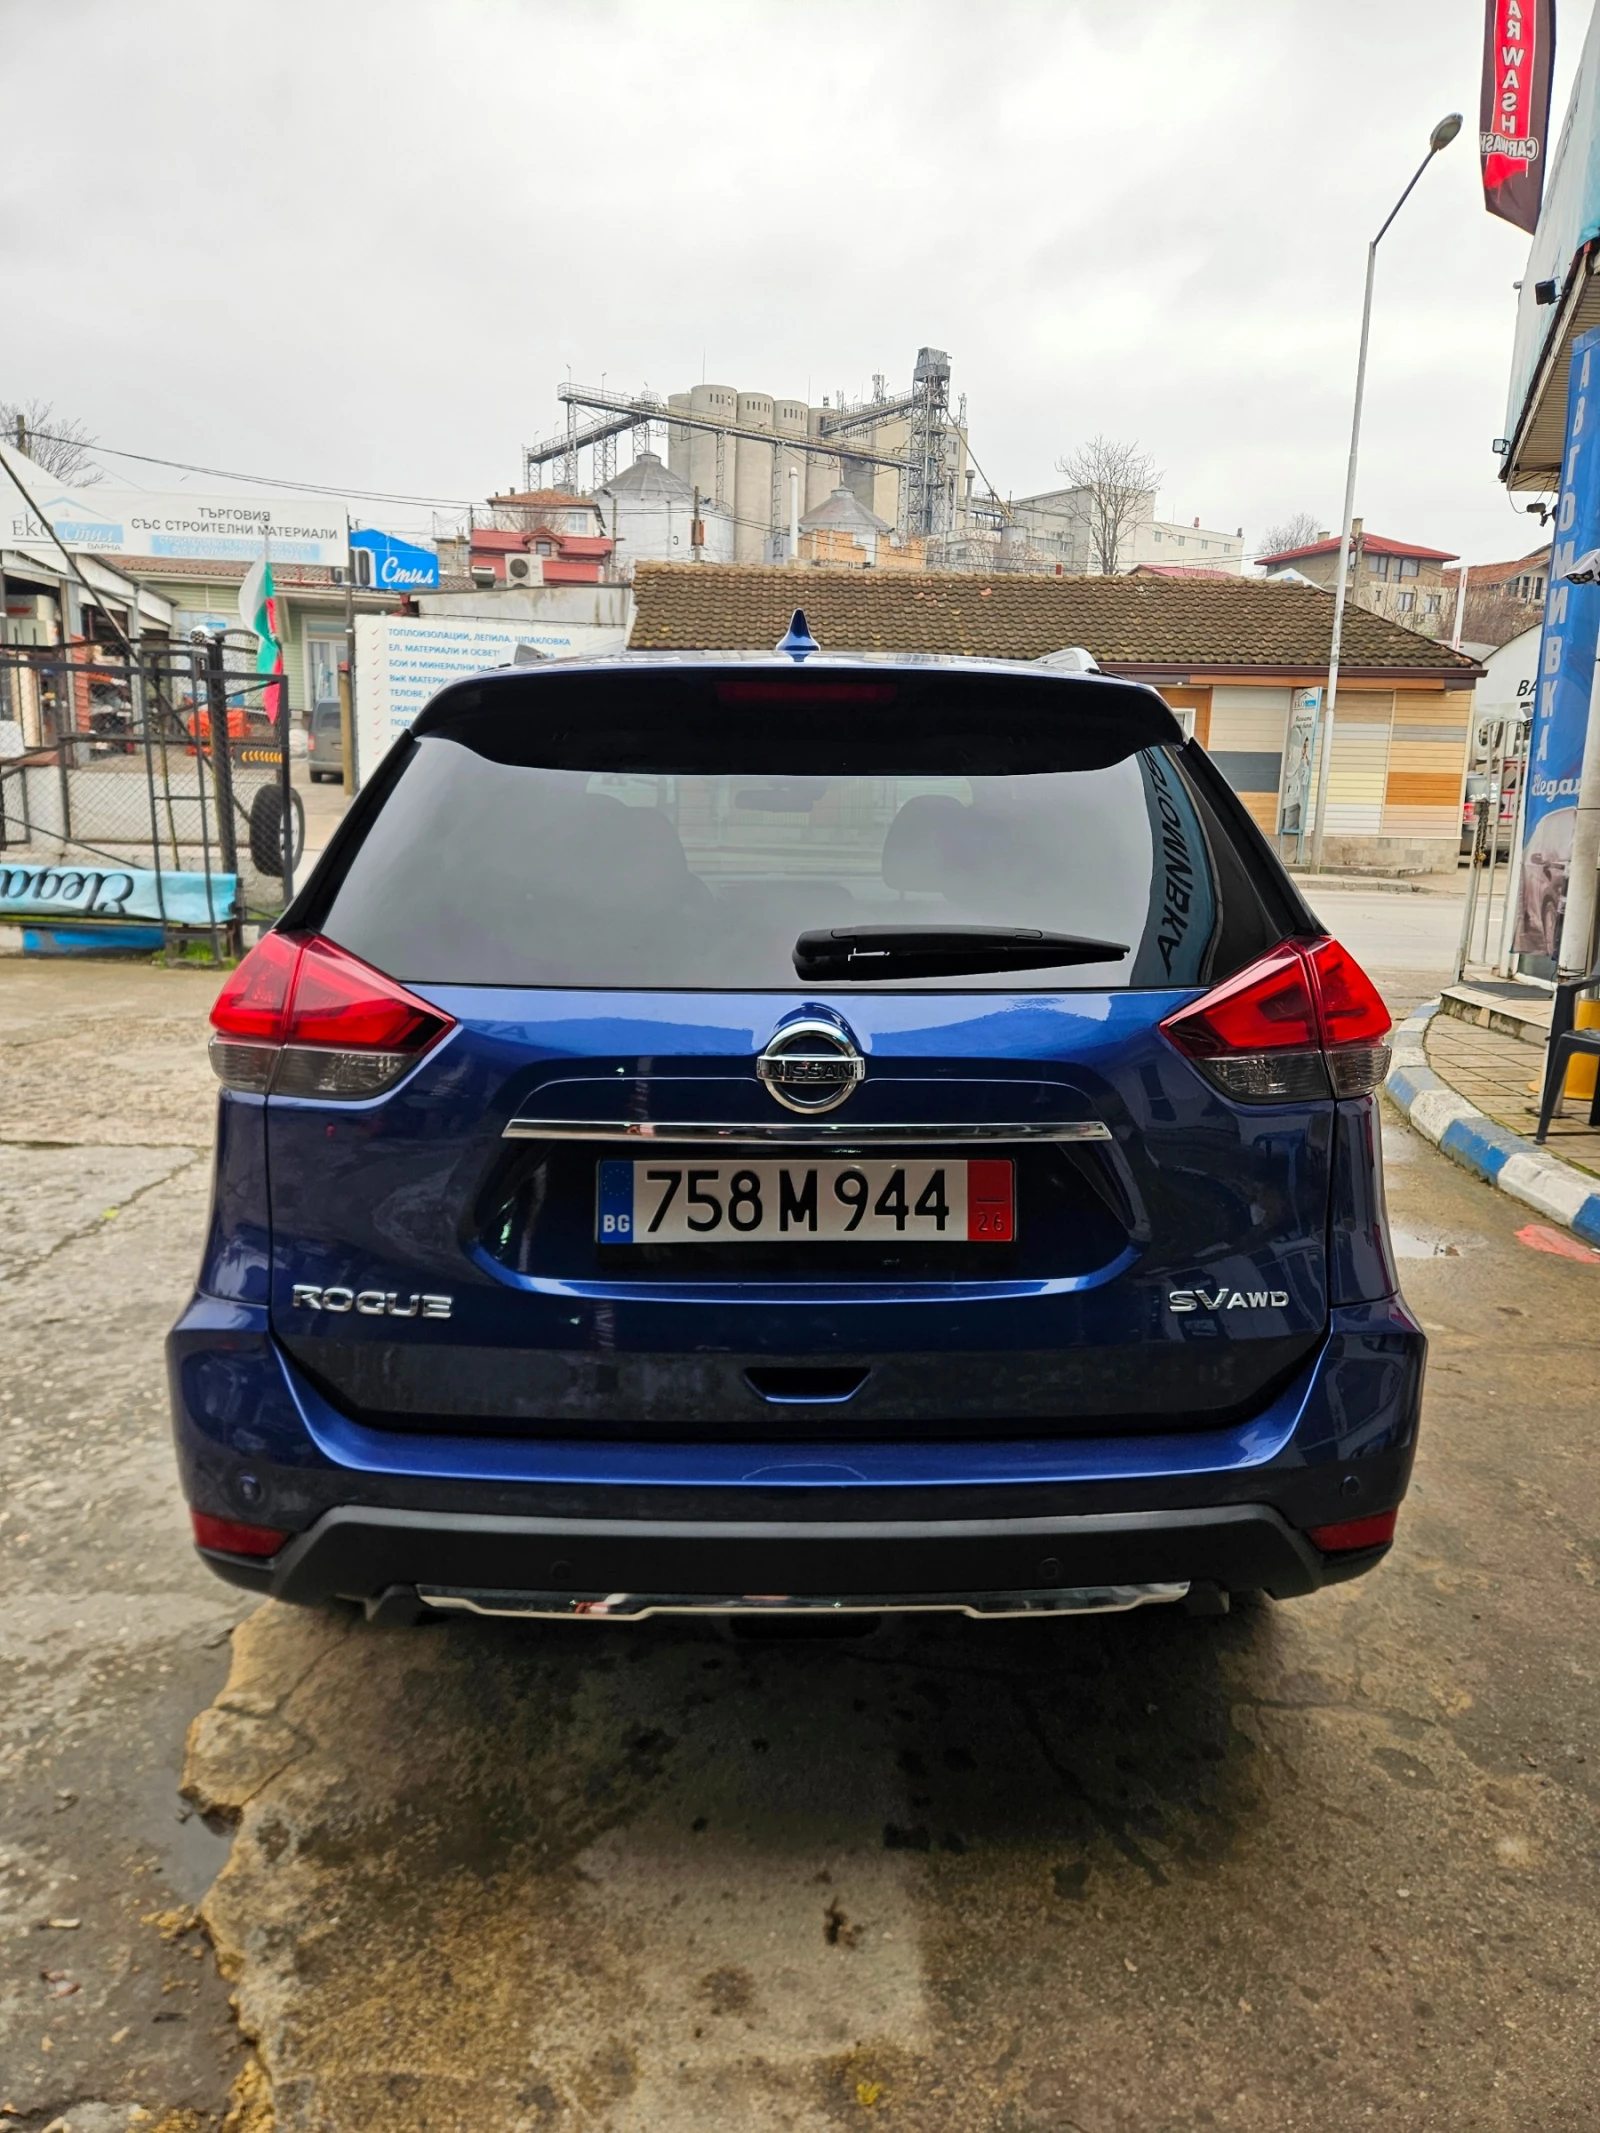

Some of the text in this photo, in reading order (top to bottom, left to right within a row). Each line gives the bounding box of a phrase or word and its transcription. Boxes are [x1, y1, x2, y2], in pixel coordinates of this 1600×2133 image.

[198, 507, 271, 522] ТЪРГОВИЯ
[64, 523, 113, 542] Стил
[131, 518, 338, 540] СЪС СТРОИТЕЛНИ МАТЕРИАЛИ
[87, 542, 122, 551] ВАРНА
[381, 556, 434, 584] Стил
[388, 628, 472, 641] ТОПЛОИЗОЛАЦИИ,
[388, 643, 402, 652] ЕЛ.
[405, 645, 459, 655] МАТЕРИАЛИ
[470, 648, 500, 657] ОСВЕТ
[389, 659, 408, 668] БОИ
[410, 660, 417, 668] И
[419, 661, 475, 671] МИНЕРАЛНИ
[389, 674, 448, 684] ВиК МАТЕРИ
[390, 704, 421, 713] ОКАЧЕ
[769, 1060, 855, 1079] NISSAN
[603, 1168, 1005, 1233] BG 758 M 944 26
[292, 1284, 453, 1319] ROGUE
